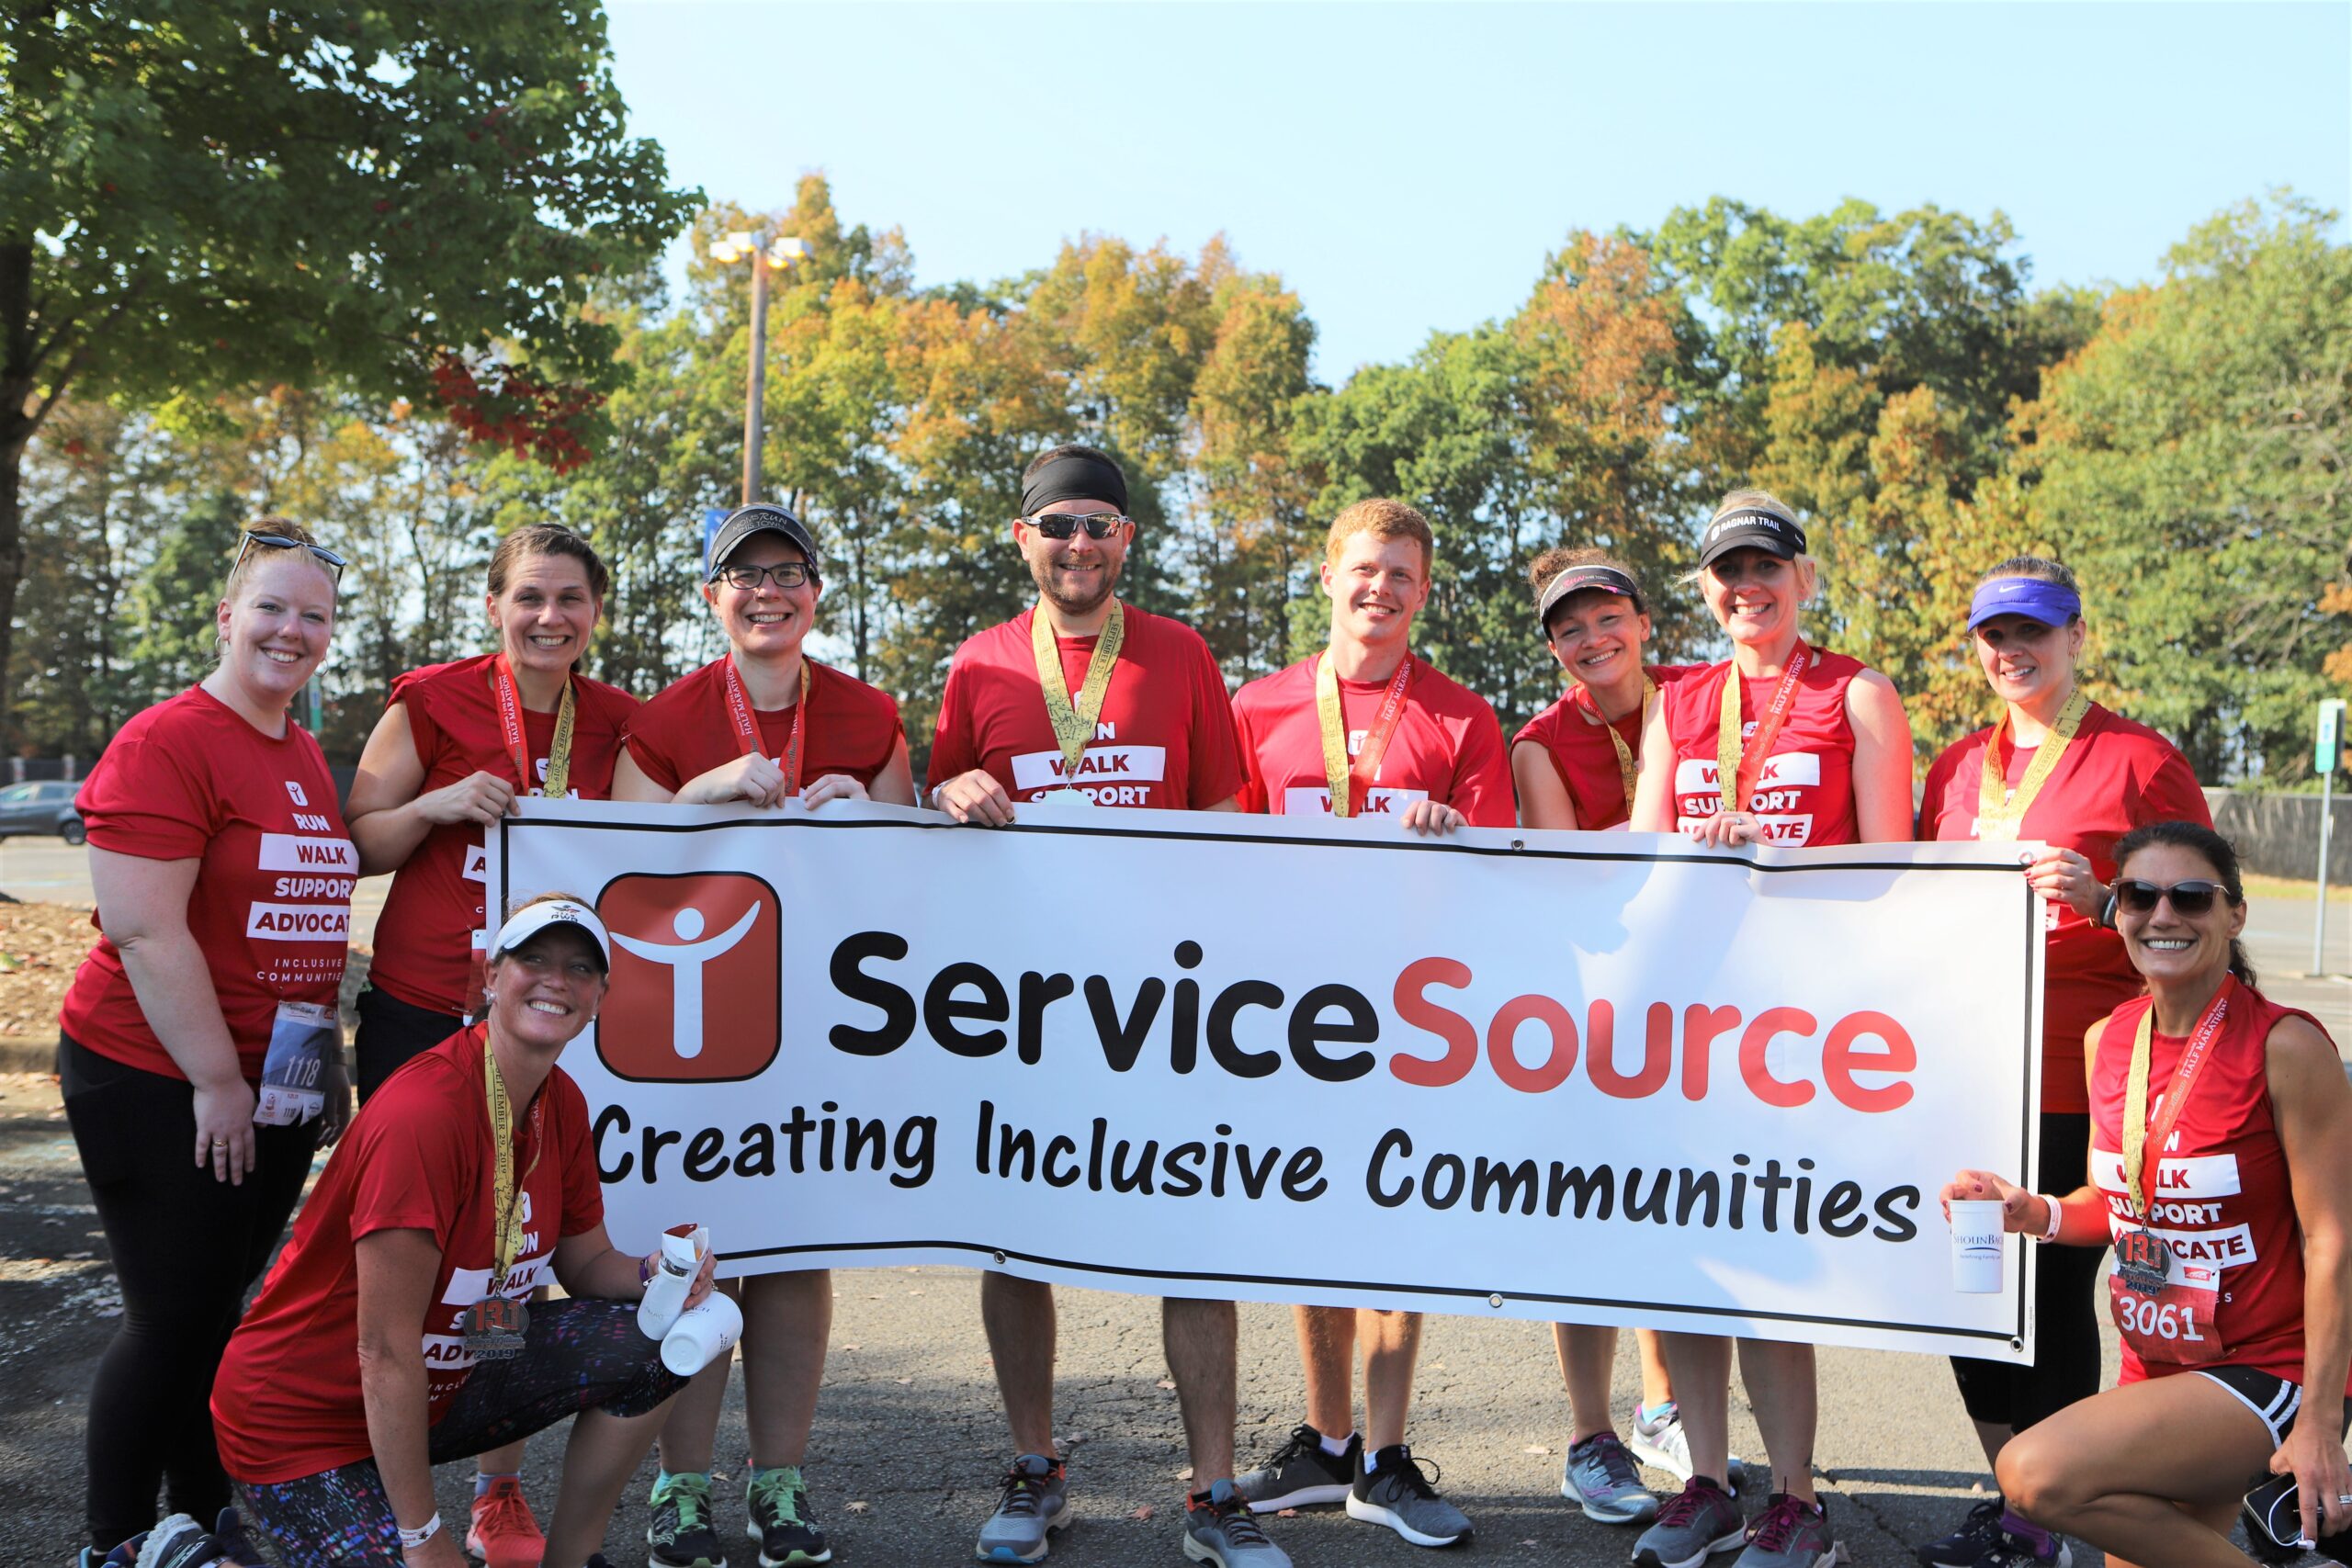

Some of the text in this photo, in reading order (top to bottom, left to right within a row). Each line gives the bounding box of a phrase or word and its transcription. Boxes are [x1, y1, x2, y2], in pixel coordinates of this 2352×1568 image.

[759, 512, 787, 525] RUN
[1720, 516, 1781, 532] RAGNAR TRAIL
[1100, 623, 1118, 663] SEPTEMBER
[503, 674, 515, 719] MARATHON
[727, 665, 753, 734] HALF MARATHON
[1090, 677, 1099, 693] 2019
[1385, 700, 1397, 721] HALF
[1392, 662, 1411, 700] MARATHON
[1774, 696, 1787, 715] HALF
[1782, 654, 1805, 702] MARATHON
[509, 721, 520, 744] HALF
[559, 702, 571, 748] SEPTEMBER
[292, 812, 331, 831] RUN
[296, 844, 348, 864] WALK
[256, 971, 343, 982] COMMUNITIE
[275, 958, 343, 968] INCLUSIVE
[829, 931, 1917, 1113] ServiceSource
[284, 1055, 321, 1087] 1118
[2183, 1051, 2199, 1078] HALF
[496, 1066, 506, 1131] SEPTEMBER
[594, 1101, 937, 1189] Creating
[976, 1100, 1328, 1202] Inclusive
[1365, 1128, 1920, 1243] Communities
[2120, 1296, 2205, 1341] 3061
[475, 1349, 515, 1359] 2019
